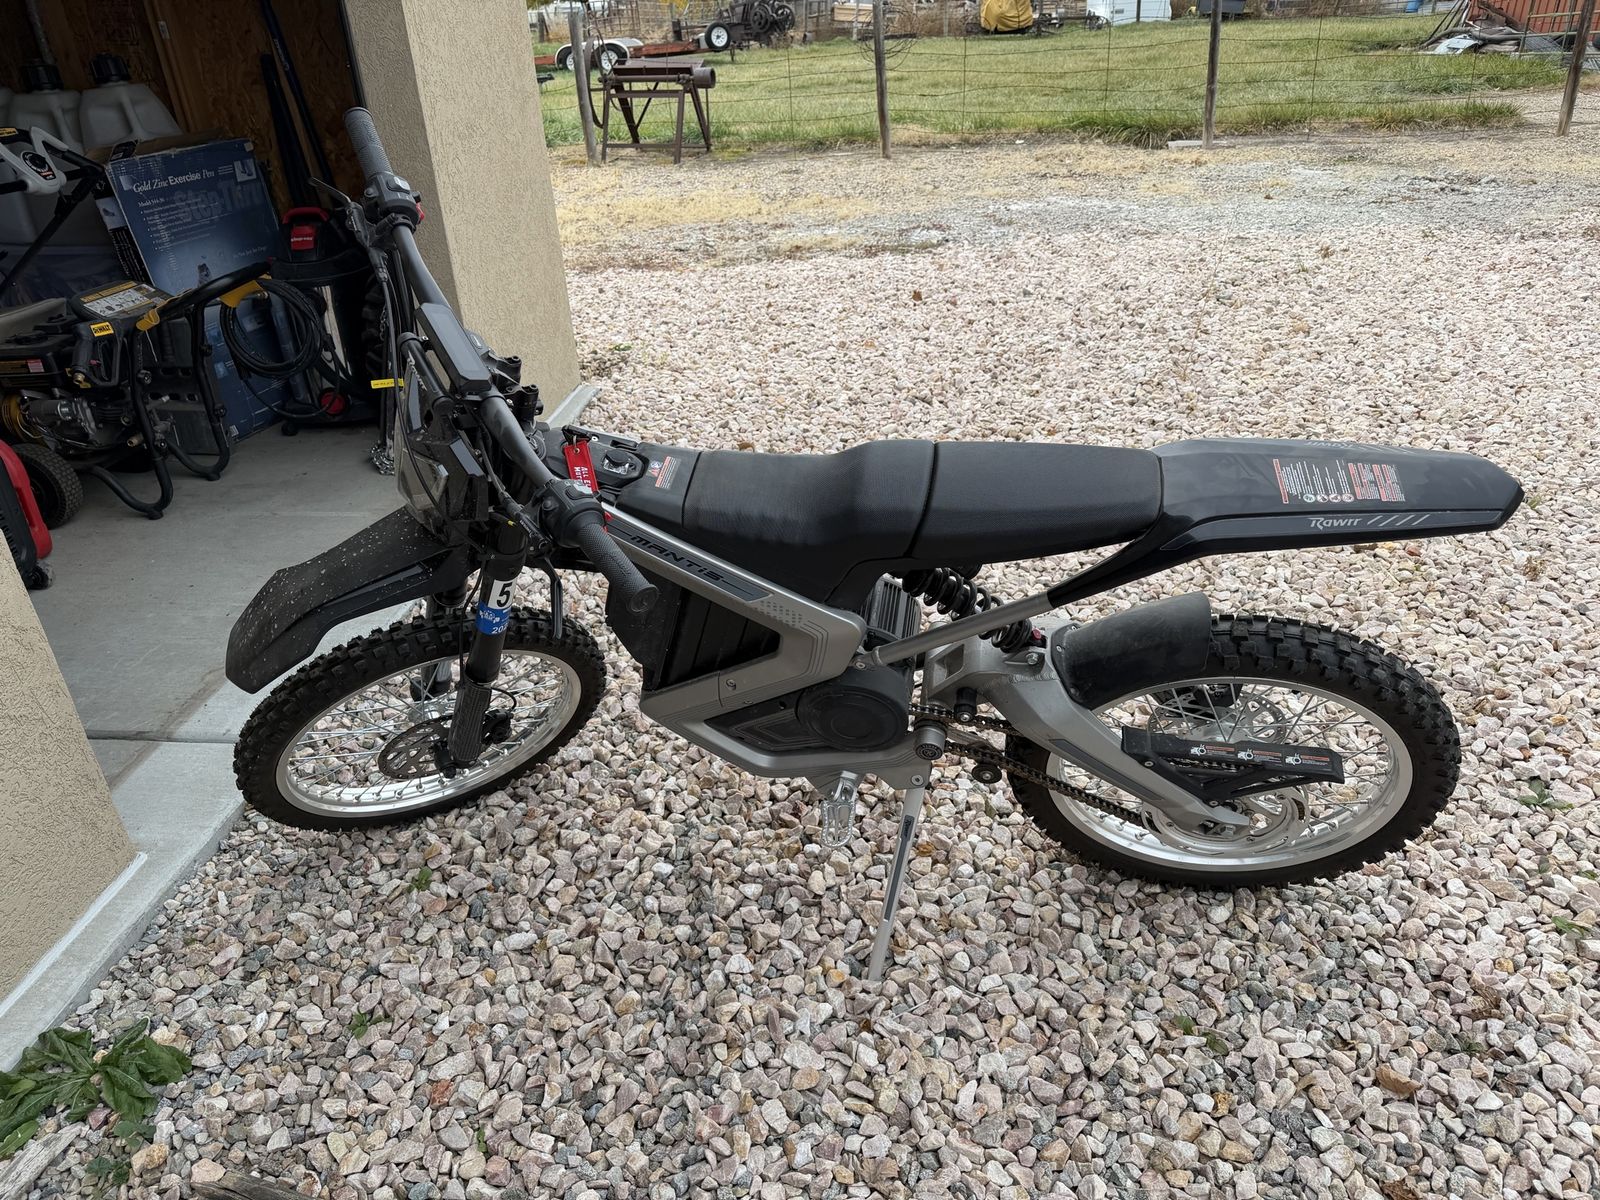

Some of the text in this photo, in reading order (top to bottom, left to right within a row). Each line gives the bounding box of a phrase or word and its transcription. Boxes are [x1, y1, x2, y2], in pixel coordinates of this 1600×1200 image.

[133, 180, 151, 193] Gold
[152, 179, 168, 189] Zinc
[168, 171, 202, 185] Exercise
[202, 169, 215, 179] Pen
[1307, 517, 1363, 530] Rawrr
[631, 535, 724, 582] MANTIS
[496, 582, 513, 608] 5
